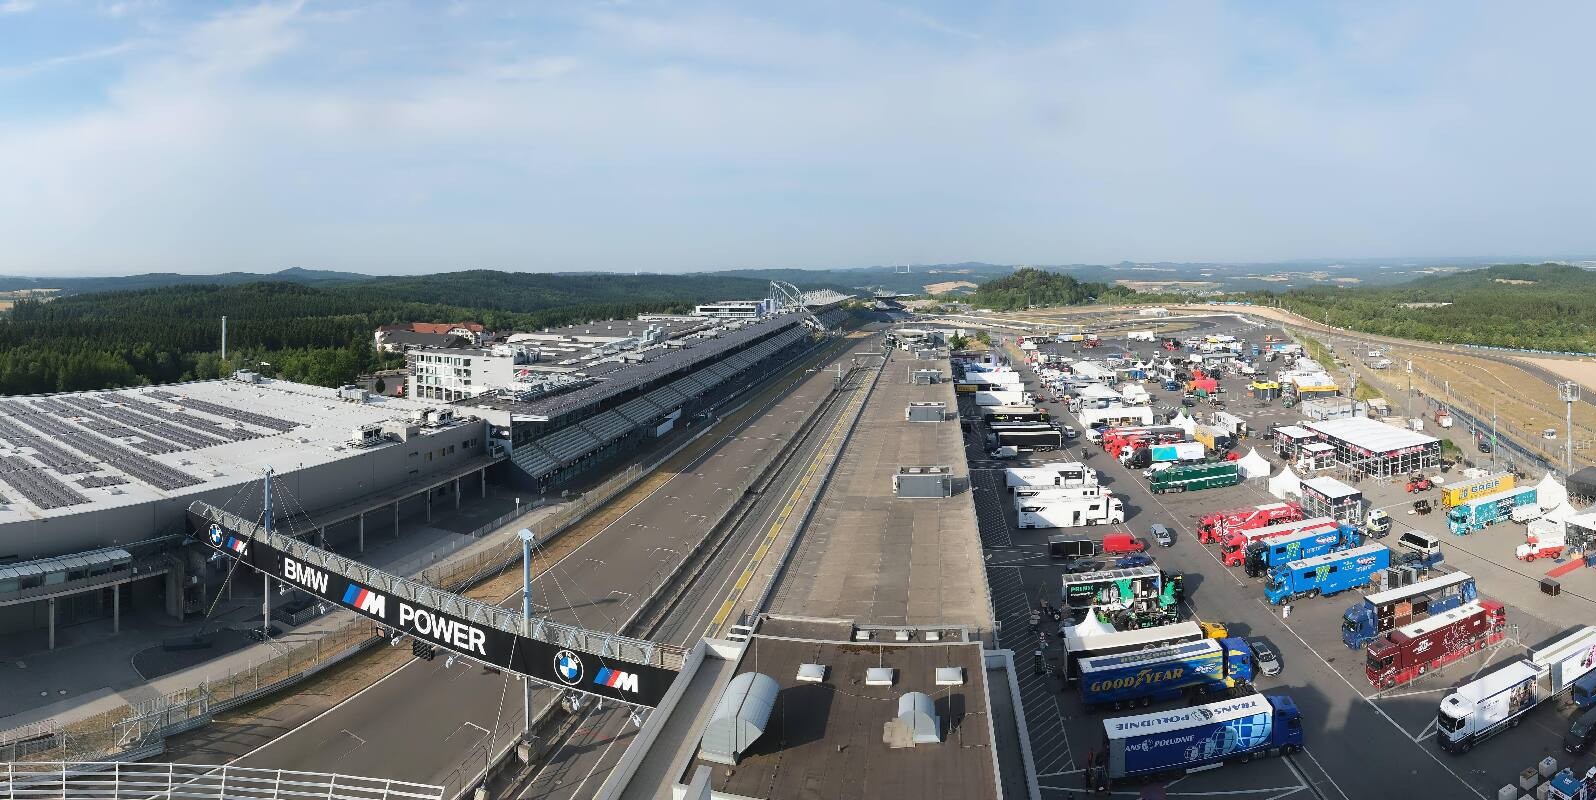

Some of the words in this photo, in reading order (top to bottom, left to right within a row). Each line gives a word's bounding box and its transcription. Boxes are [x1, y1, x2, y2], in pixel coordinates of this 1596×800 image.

[1471, 480, 1500, 493] GREIF
[1070, 584, 1094, 593] PRINX
[283, 557, 329, 594] BMW
[399, 602, 487, 656] POWER
[1090, 668, 1185, 692] GOODYEAR
[1213, 700, 1258, 715] TRANS
